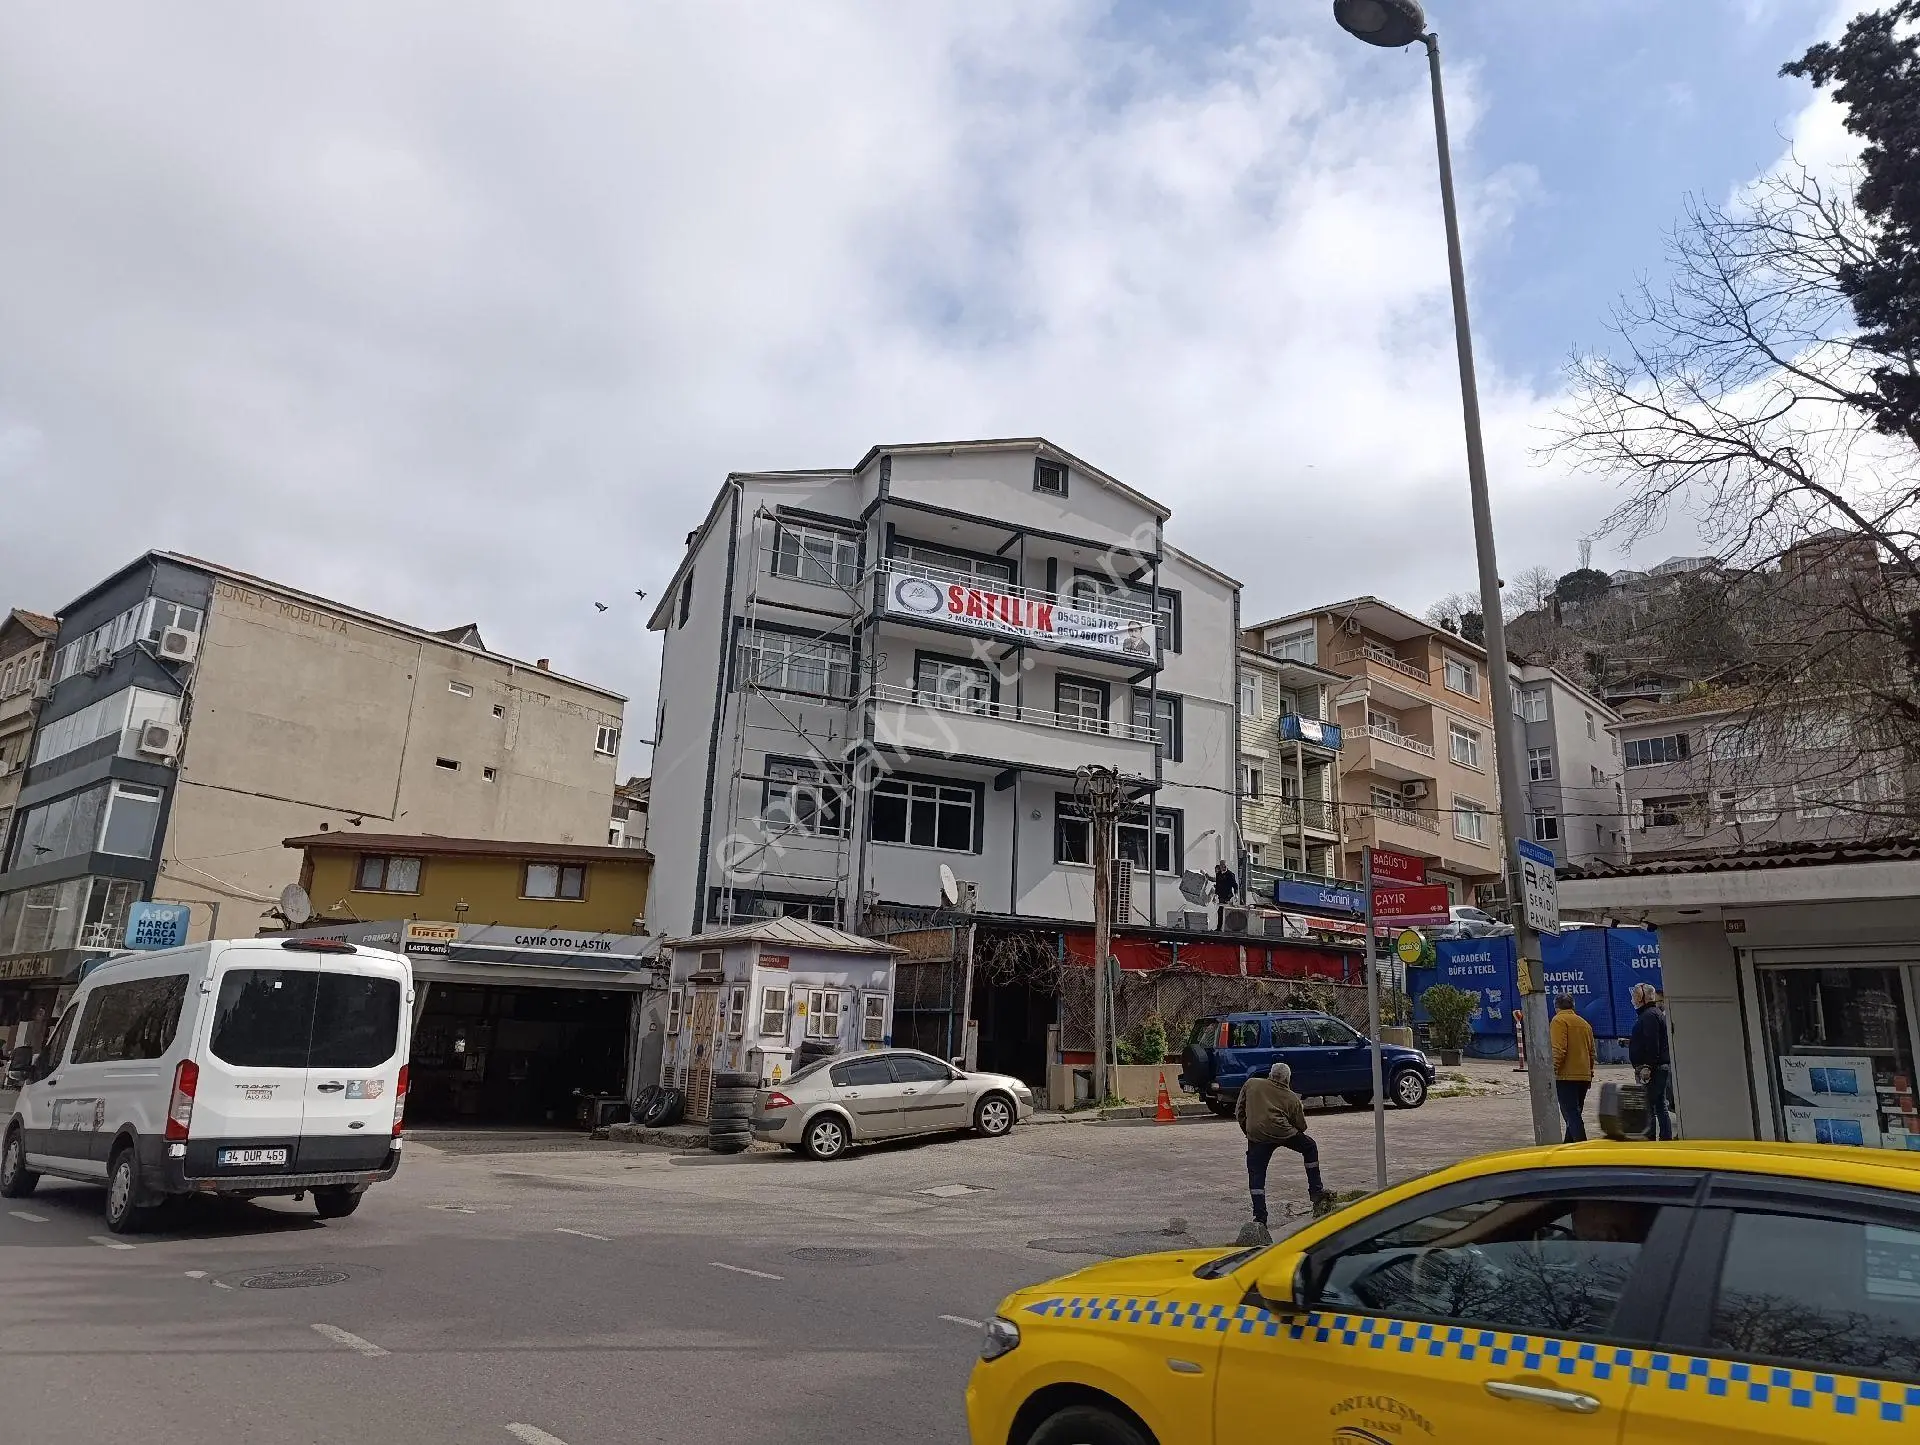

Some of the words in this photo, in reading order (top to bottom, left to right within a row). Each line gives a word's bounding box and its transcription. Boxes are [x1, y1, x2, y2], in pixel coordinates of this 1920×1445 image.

[948, 585, 1053, 632] SATILIK
[1319, 889, 1350, 906] ekomini
[1375, 893, 1406, 906] ÇAYIR
[138, 920, 177, 930] HARCA
[136, 928, 176, 938] HARCA
[550, 937, 571, 948] OTO
[1451, 951, 1491, 964] KARADENİZ
[1467, 965, 1473, 975] &
[1473, 964, 1496, 975] TEKEL
[1543, 968, 1584, 982] RADENİZ
[1560, 984, 1592, 995] TEKEL
[226, 1151, 239, 1162] 34
[243, 1151, 262, 1162] DUR
[266, 1150, 284, 1161] 469
